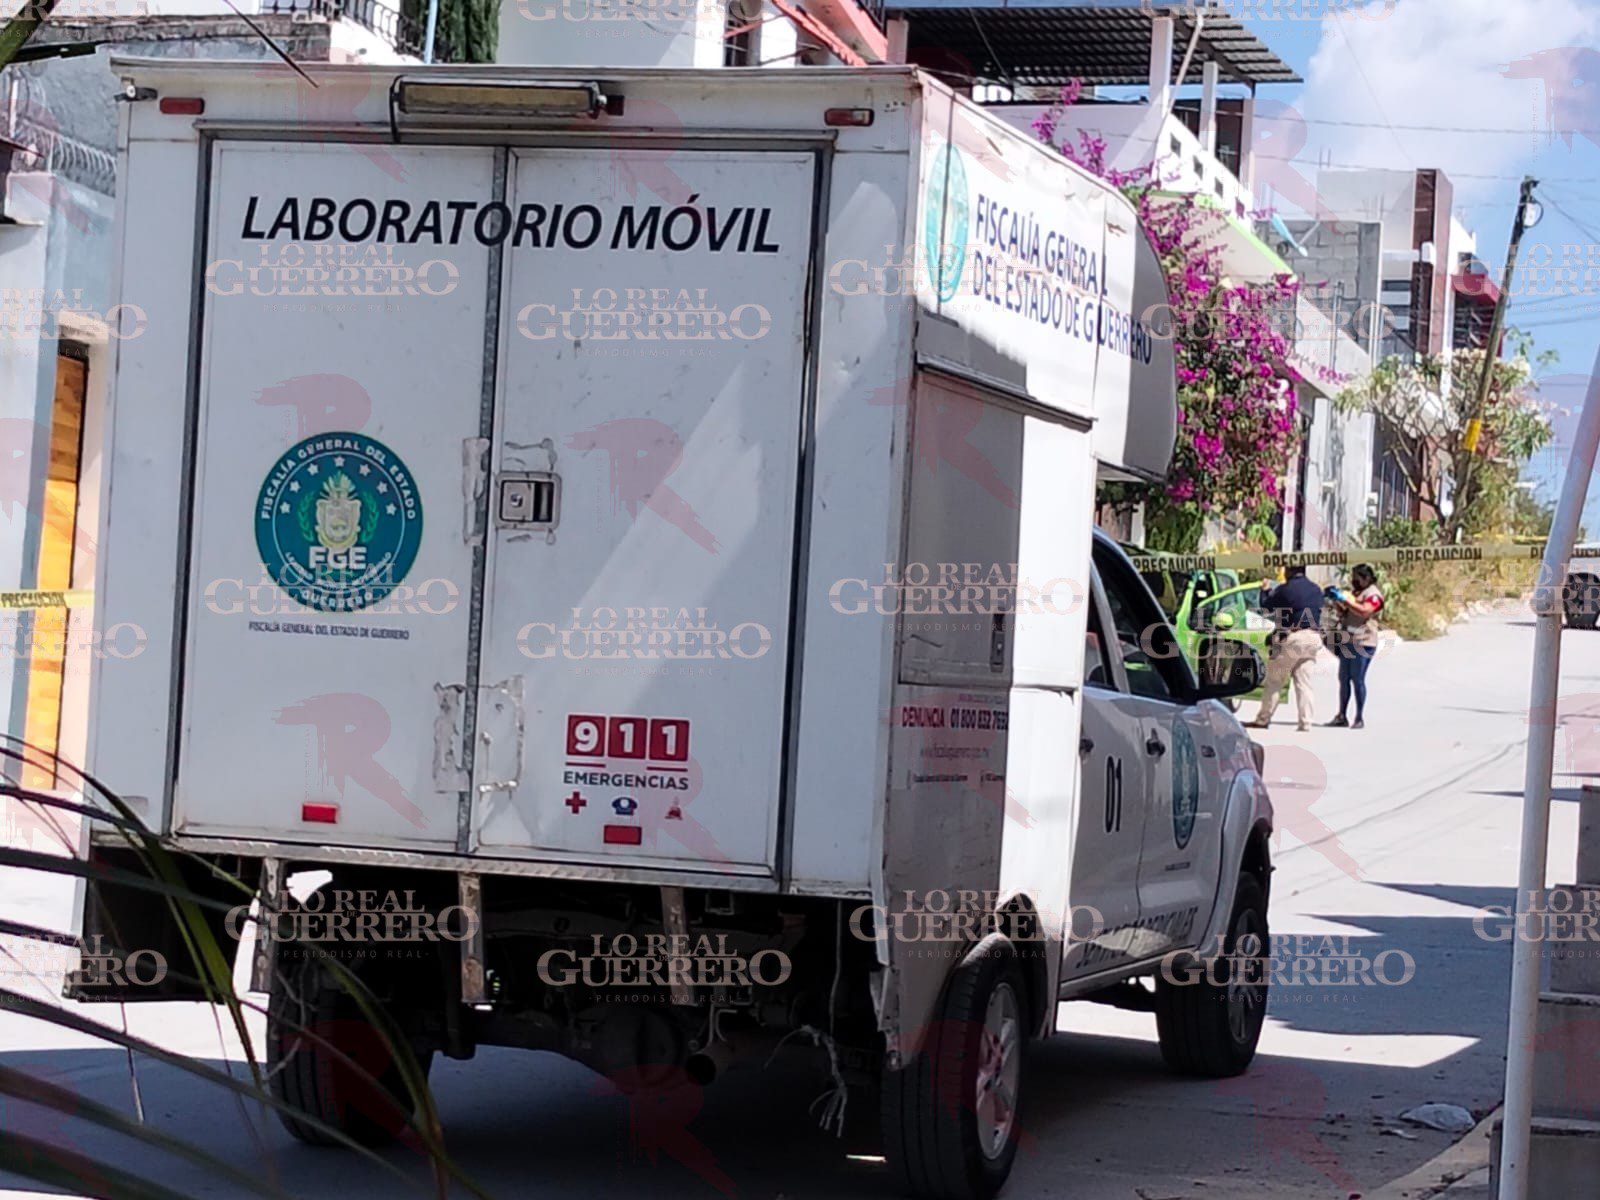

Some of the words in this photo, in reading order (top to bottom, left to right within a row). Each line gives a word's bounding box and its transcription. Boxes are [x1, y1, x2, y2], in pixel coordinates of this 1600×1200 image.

[241, 196, 602, 249] LABORATORIO
[610, 193, 780, 253] MÓVIL
[976, 193, 1040, 268] FISCALÍA
[1044, 230, 1109, 297] GENERAL
[972, 250, 1001, 305] DEL
[1005, 264, 1063, 330] ESTADO
[1065, 291, 1080, 338] DE
[1083, 302, 1152, 365] GUERRERO
[261, 458, 297, 520] FISCALÍA
[298, 438, 360, 459] GENERAL
[365, 445, 387, 465] DEL
[389, 465, 416, 520] ESTADO
[309, 546, 368, 570] FGE
[1133, 556, 1216, 572] PRECAUCION
[1263, 551, 1348, 568] PRECAUCION
[1396, 547, 1482, 563] PRECAUCION
[902, 705, 945, 728] DENUNCIA
[571, 719, 683, 758] 911
[563, 770, 689, 791] EMERGENCIAS
[1105, 755, 1122, 833] 01
